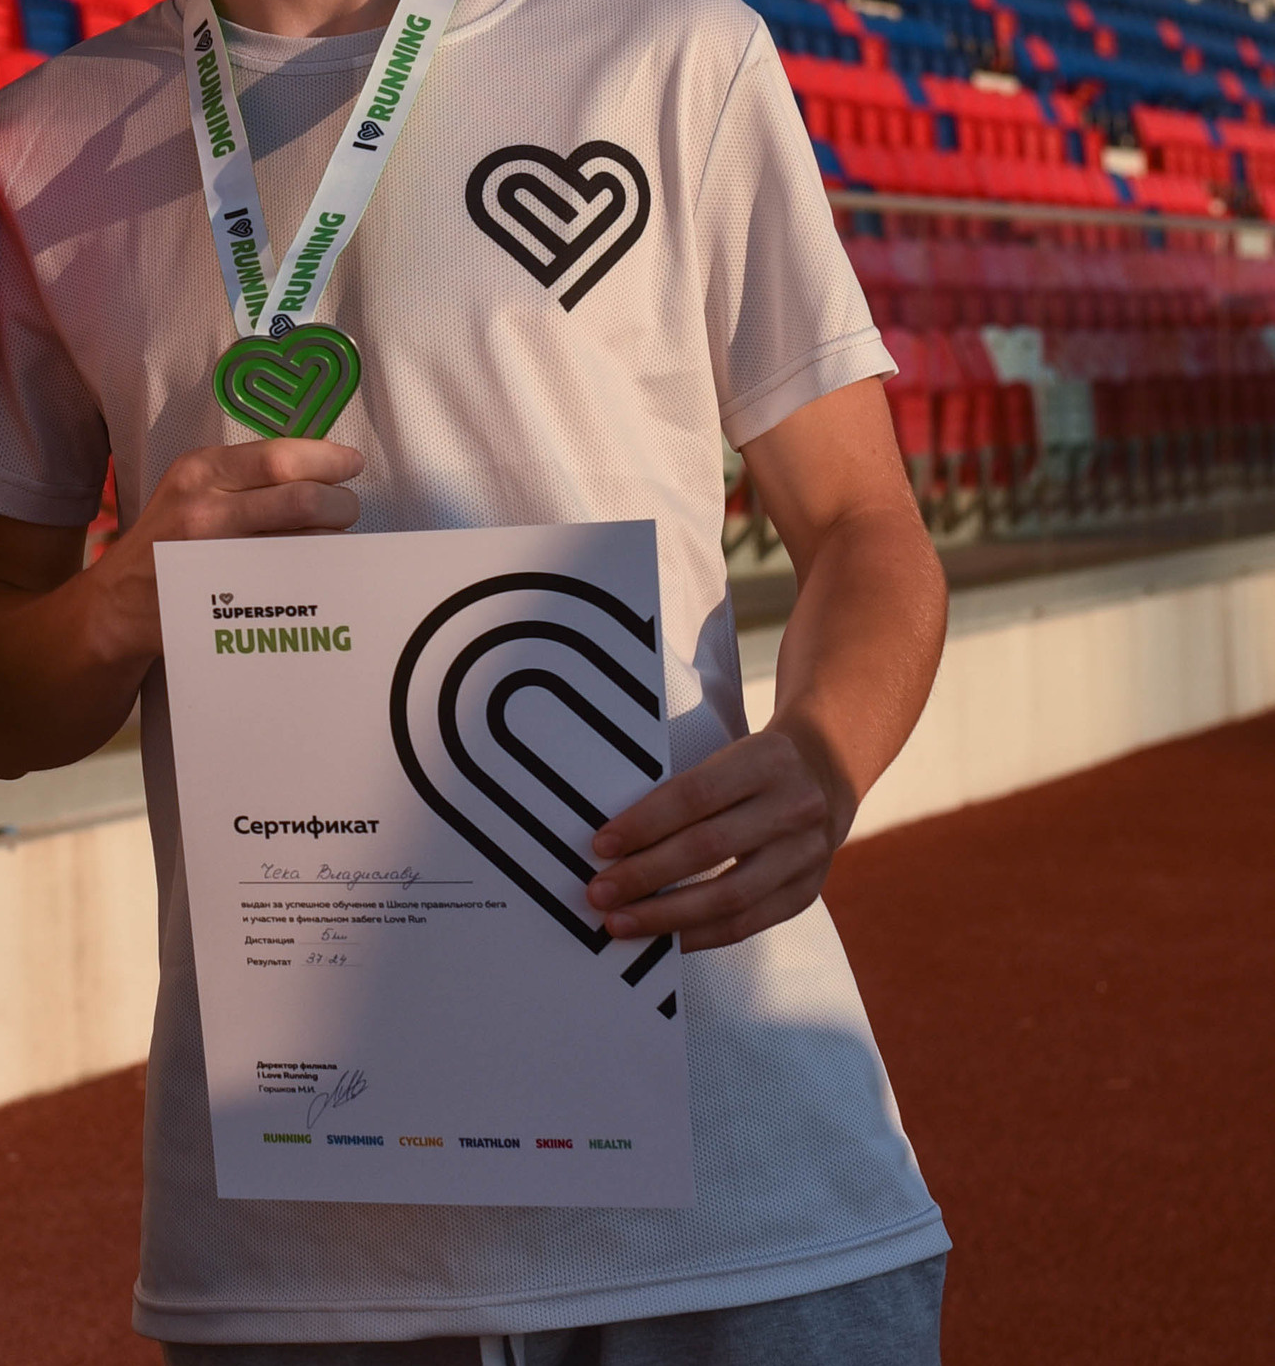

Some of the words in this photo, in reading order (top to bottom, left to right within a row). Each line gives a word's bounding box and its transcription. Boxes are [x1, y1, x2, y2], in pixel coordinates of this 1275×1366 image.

[193, 18, 208, 38] I
[352, 141, 378, 152] I
[366, 13, 432, 122] RUNNING
[196, 48, 236, 159] RUNNING
[224, 207, 249, 220] I
[277, 211, 346, 312] RUNNING
[212, 605, 318, 619] SUPERSPORT
[214, 625, 352, 654] RUNNING
[233, 815, 380, 840] Сертификат
[316, 863, 421, 891] Владиславу
[241, 901, 271, 910] выдан
[284, 901, 331, 911] успешное
[332, 900, 377, 911] обучение
[386, 900, 419, 909] Школе
[420, 901, 484, 911] правильного
[485, 899, 508, 909] бега
[251, 916, 287, 925] участие
[296, 914, 350, 925] финальном
[351, 914, 382, 924] забеге
[384, 914, 406, 924] Love
[408, 914, 427, 924] Run
[244, 936, 295, 945] Дистанция
[247, 956, 292, 967] Результат
[256, 1060, 299, 1071] Директор
[299, 1061, 338, 1072] филиала
[262, 1071, 282, 1080] Love
[283, 1071, 319, 1082] Running
[263, 1133, 312, 1144] RUNNING
[326, 1134, 384, 1146] SWIMMING
[398, 1136, 444, 1147] CYCLING
[458, 1137, 520, 1149] TRIATHLON
[535, 1138, 573, 1149] SKIING
[588, 1139, 632, 1150] HEALTH
